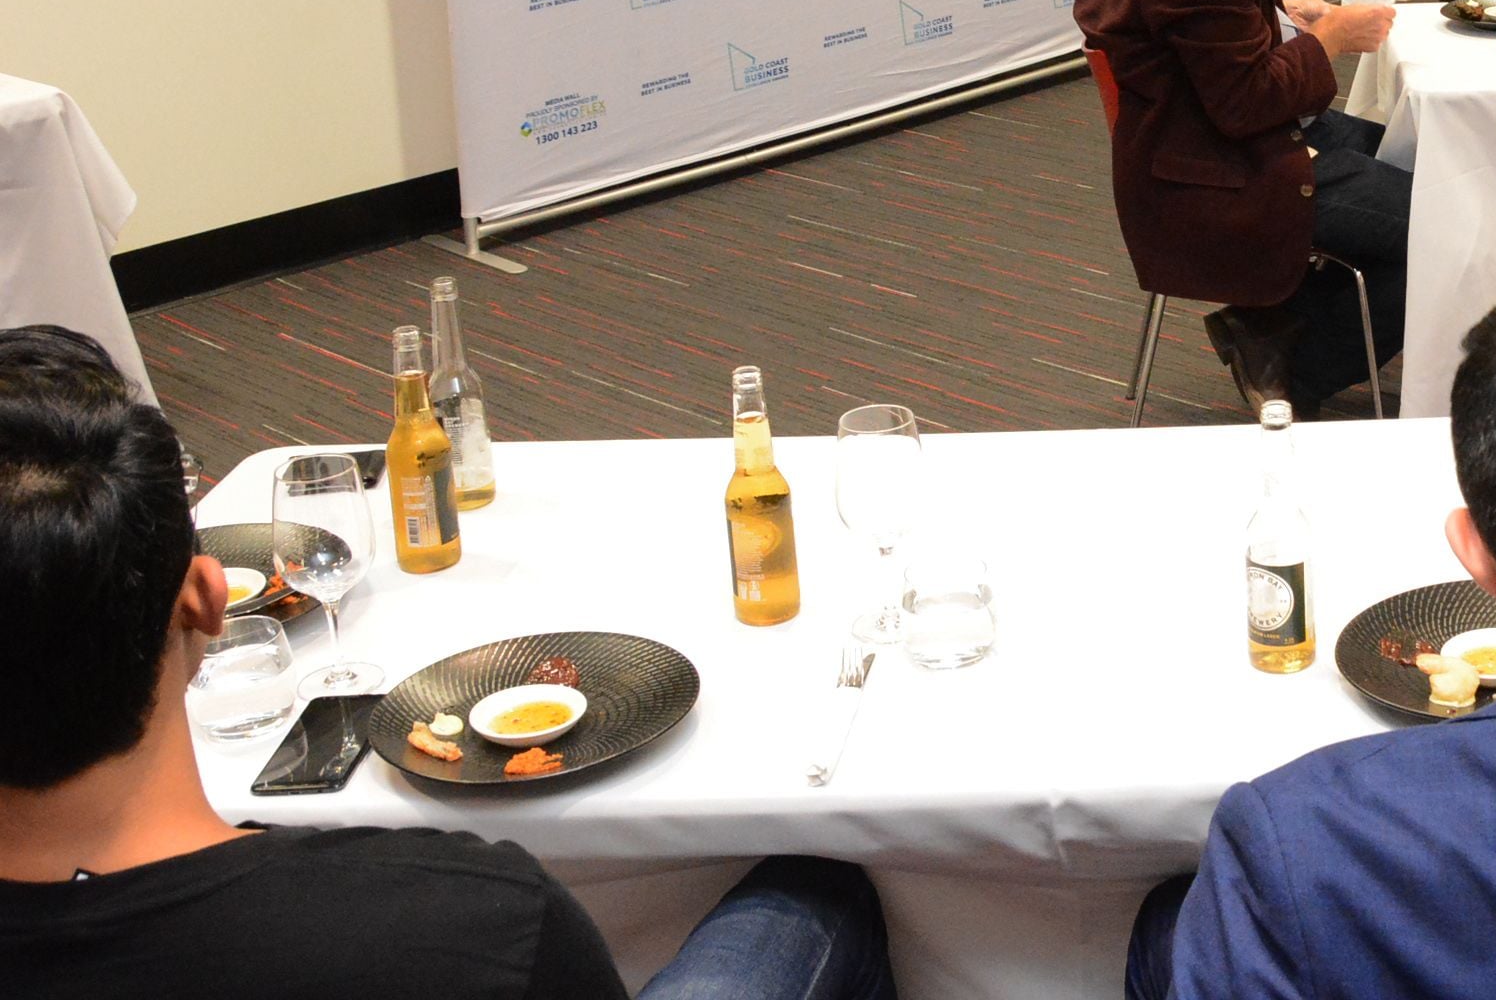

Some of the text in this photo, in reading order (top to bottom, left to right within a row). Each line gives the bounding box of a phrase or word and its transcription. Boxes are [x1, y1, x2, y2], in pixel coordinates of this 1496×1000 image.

[564, 93, 580, 102] WALL
[532, 100, 606, 127] PROMOFLEX
[536, 132, 559, 145] 1300
[562, 126, 578, 138] 143
[580, 121, 598, 133] 223
